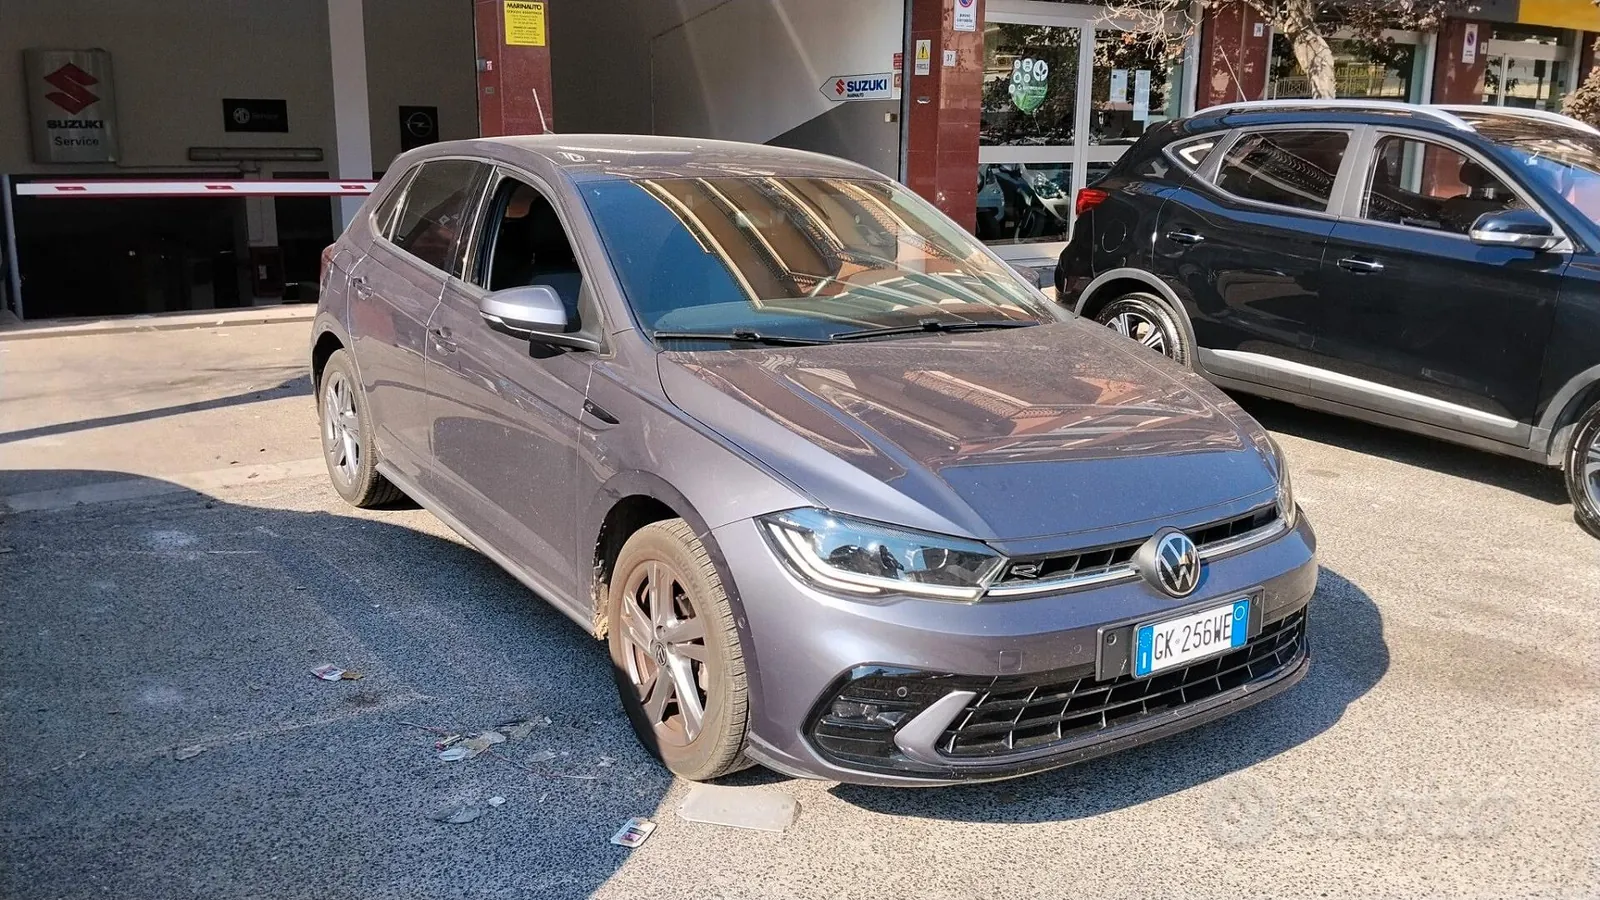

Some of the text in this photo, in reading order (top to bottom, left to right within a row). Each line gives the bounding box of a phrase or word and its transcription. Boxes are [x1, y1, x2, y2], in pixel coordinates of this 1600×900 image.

[847, 79, 887, 92] SUZUKI
[46, 119, 104, 129] SUZUKI
[54, 136, 99, 146] Service
